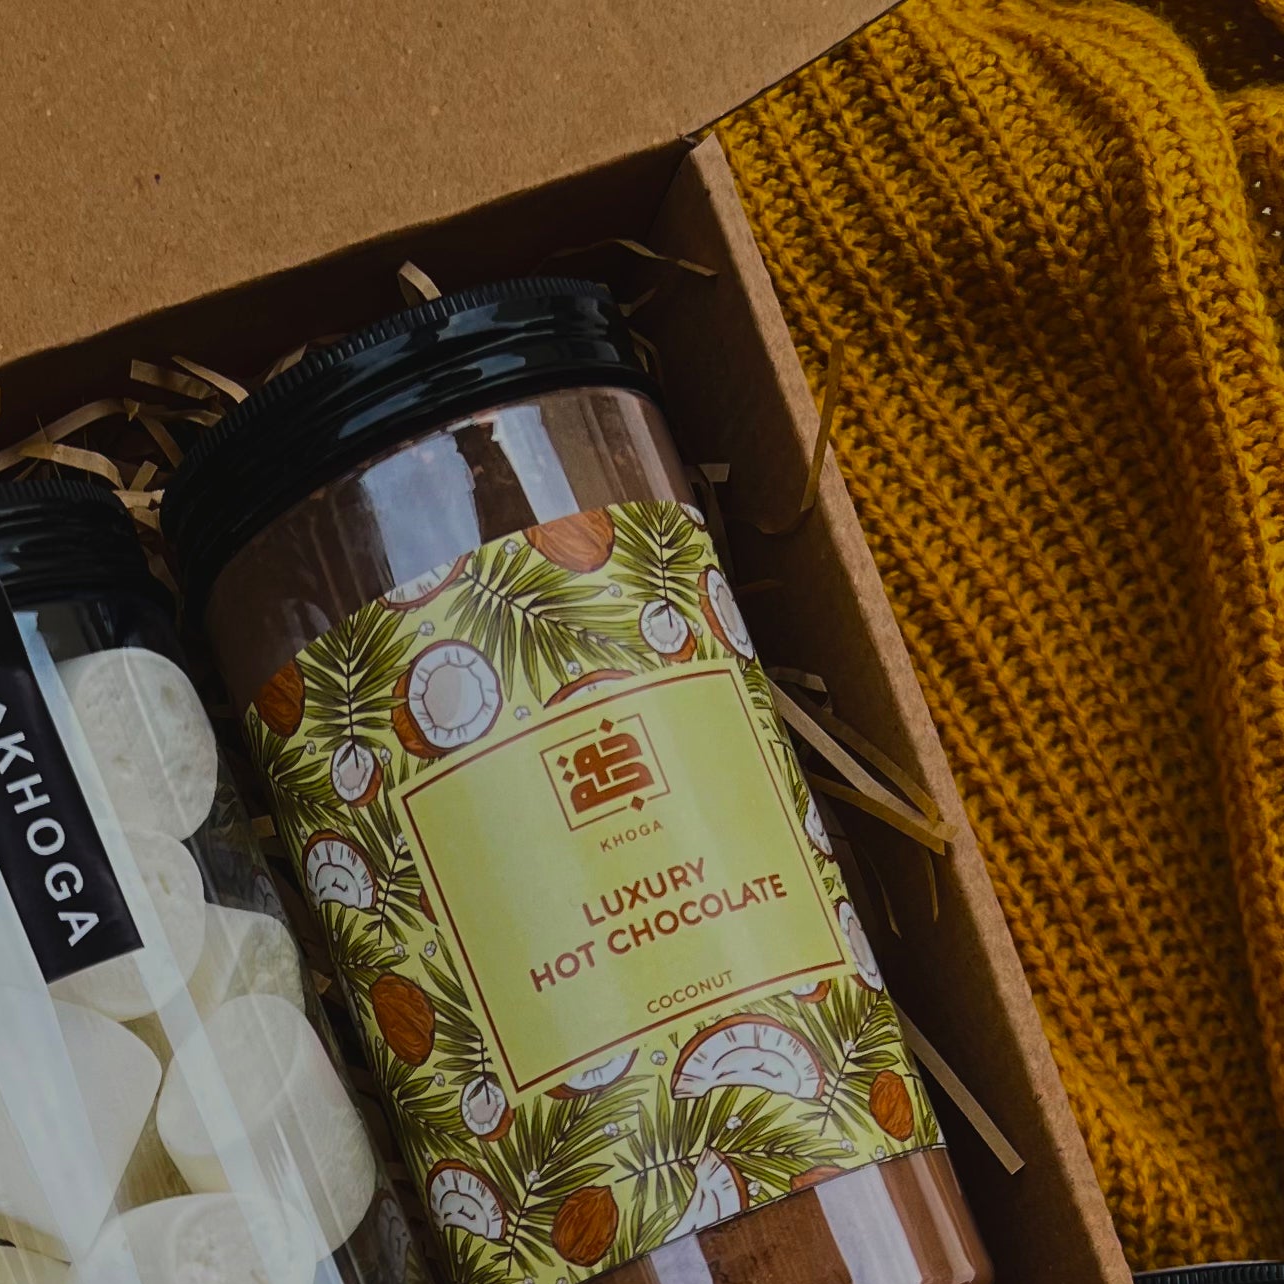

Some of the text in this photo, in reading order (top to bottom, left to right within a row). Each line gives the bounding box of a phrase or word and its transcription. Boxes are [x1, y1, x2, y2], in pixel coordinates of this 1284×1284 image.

[600, 820, 664, 853] KHOGA
[582, 857, 707, 927] LUXURY
[530, 873, 788, 993] HOT CHOCOLATE
[647, 970, 734, 1015] COCONUT
